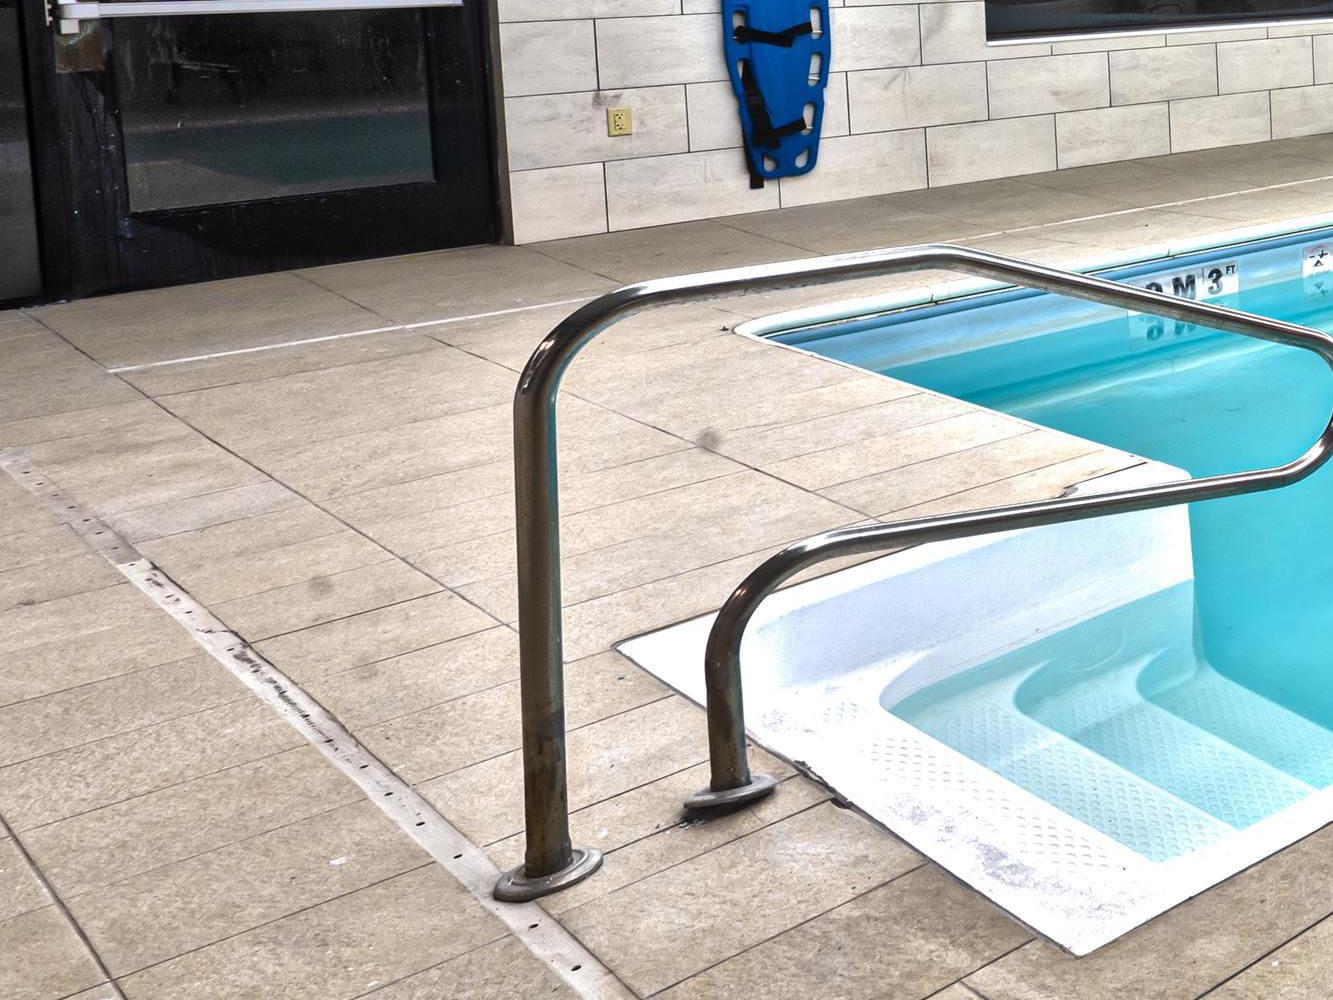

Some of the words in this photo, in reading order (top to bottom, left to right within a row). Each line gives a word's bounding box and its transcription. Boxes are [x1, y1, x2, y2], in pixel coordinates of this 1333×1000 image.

[1171, 273, 1196, 300] M
[1207, 267, 1223, 295] 3
[1225, 264, 1236, 275] FT
